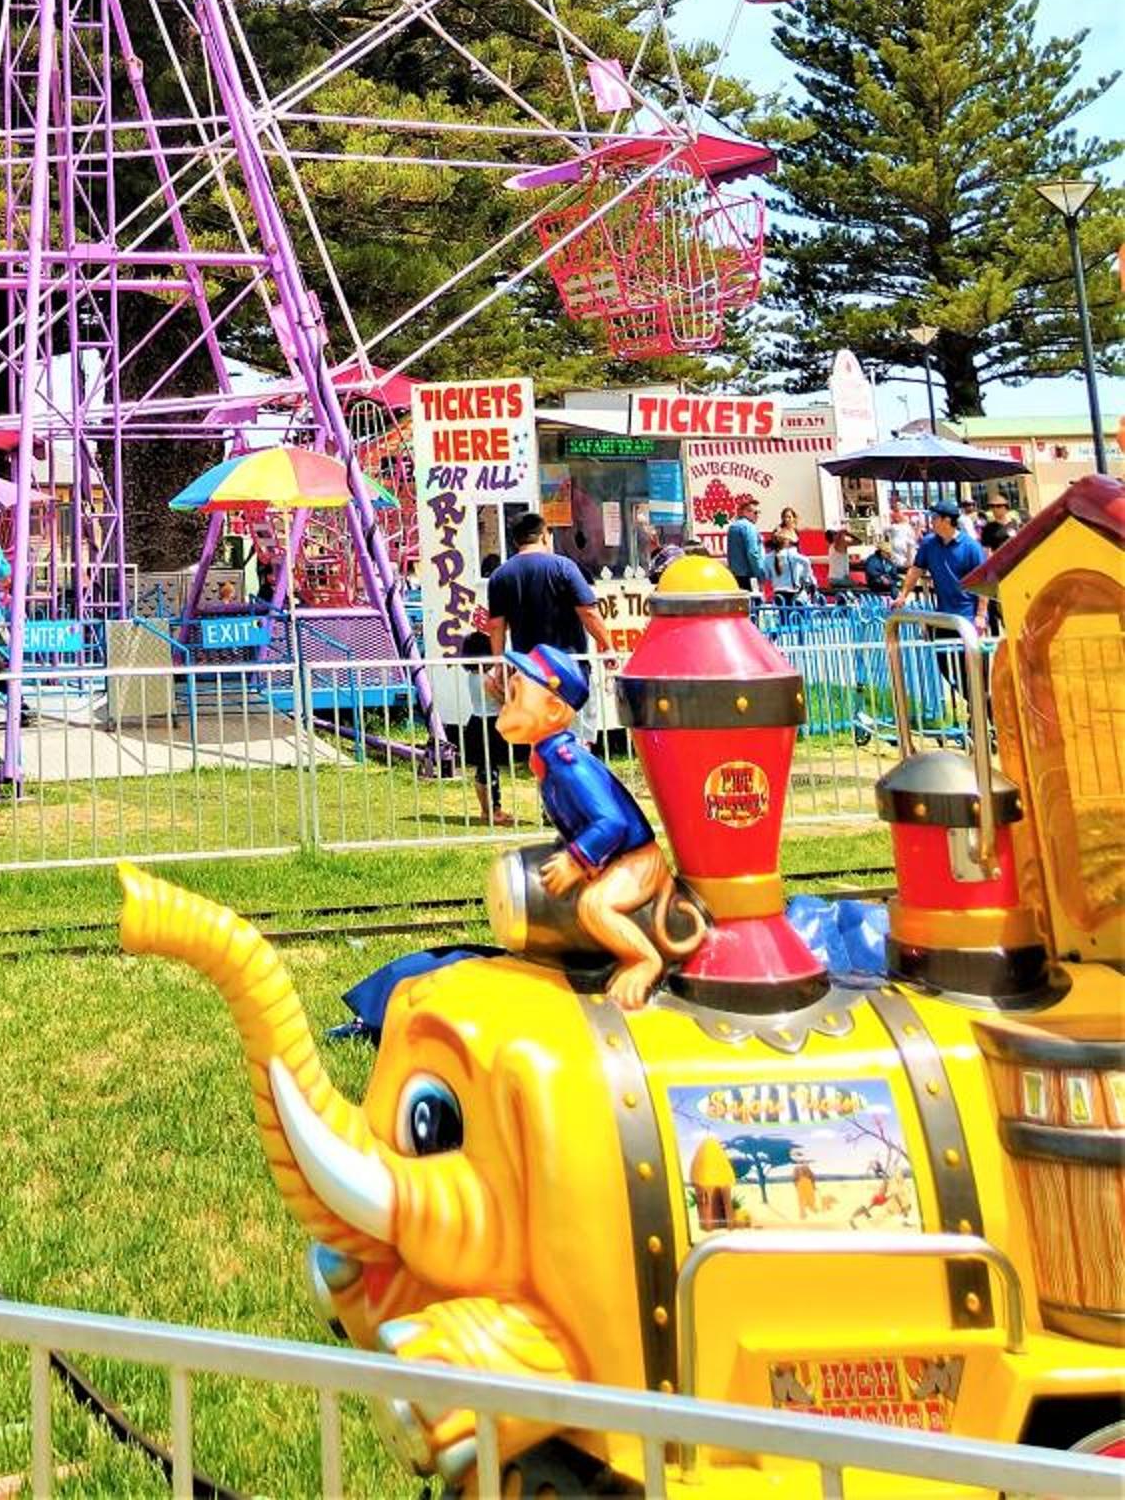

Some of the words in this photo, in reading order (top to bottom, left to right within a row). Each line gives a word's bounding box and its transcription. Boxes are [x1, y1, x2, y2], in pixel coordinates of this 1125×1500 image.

[420, 383, 524, 421] TICKETS
[638, 397, 774, 435] TICKETS
[432, 427, 510, 462] HERE
[570, 439, 614, 453] SAFARI
[426, 465, 468, 490] FOR
[475, 465, 519, 490] ALL
[691, 461, 773, 489] WBERRIES
[427, 491, 477, 669] RIDES
[23, 627, 66, 648] ENTER
[206, 621, 251, 644] EXIT
